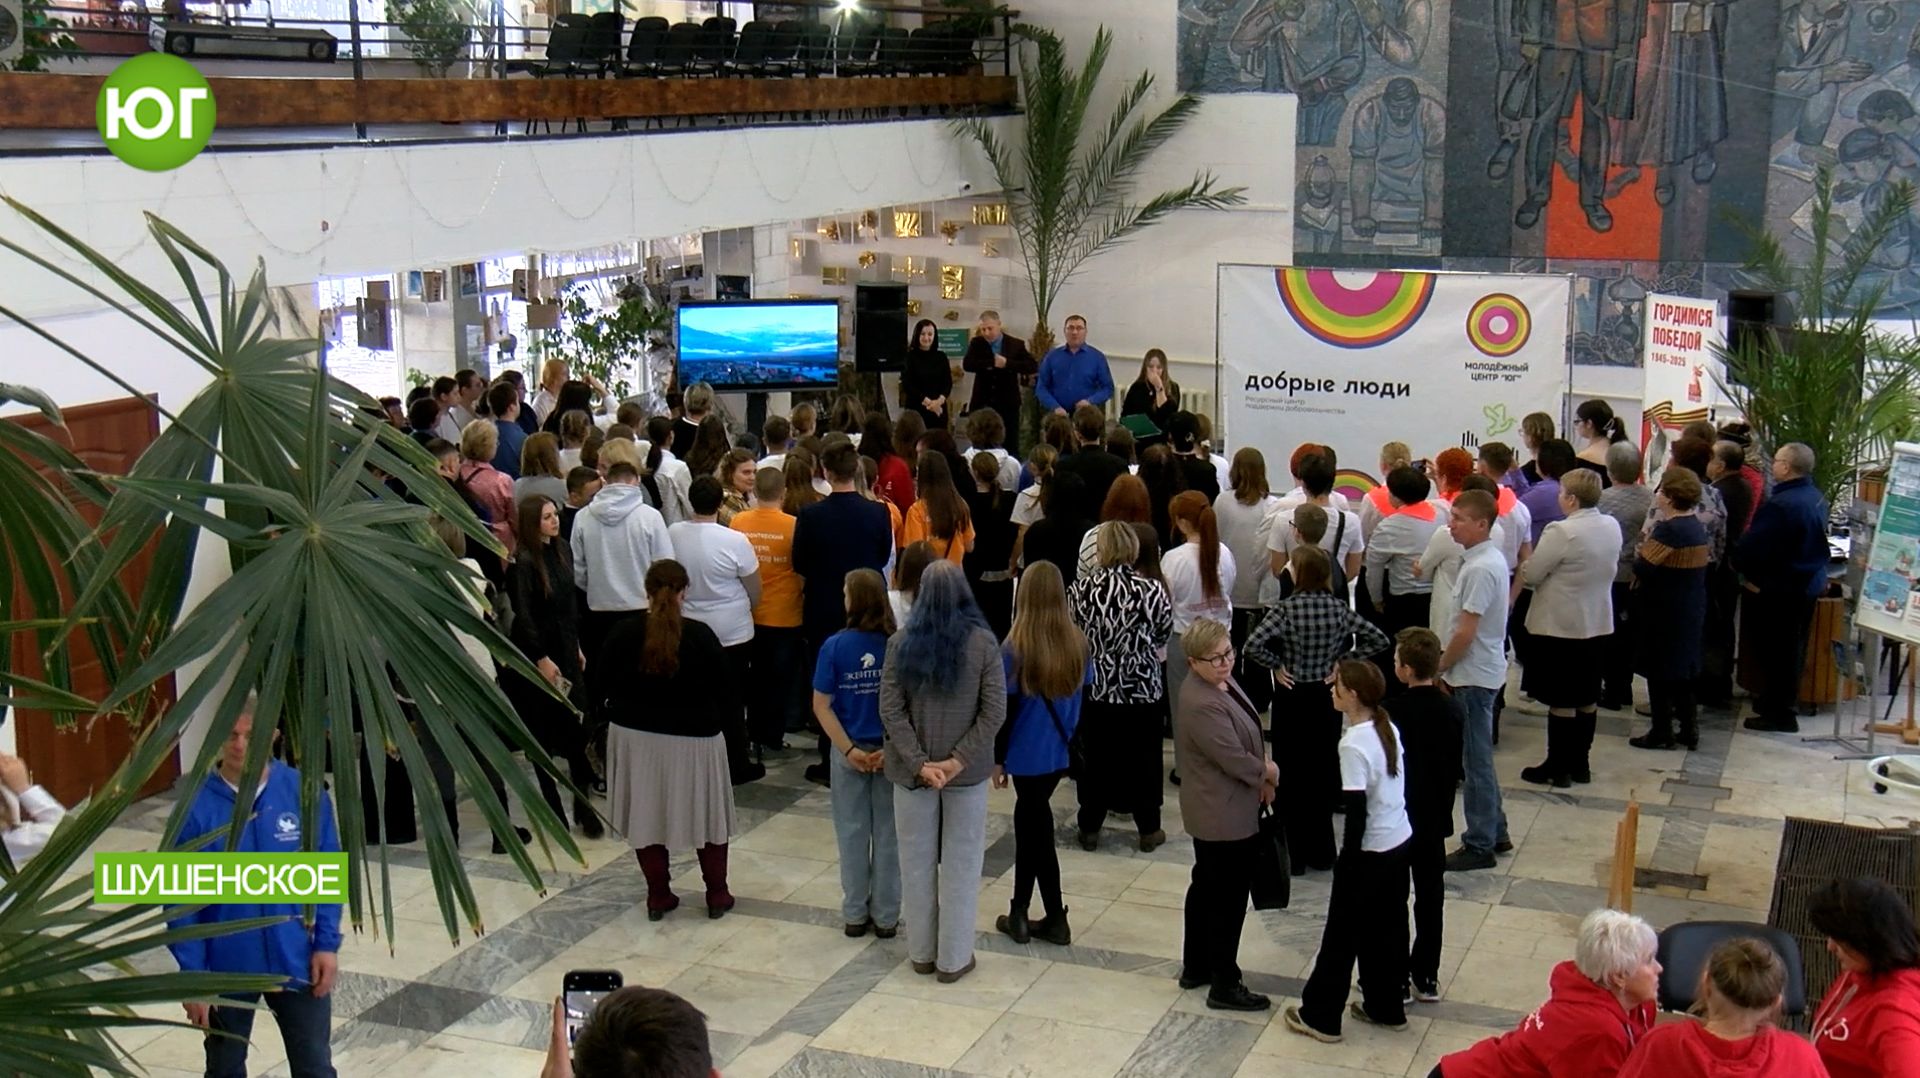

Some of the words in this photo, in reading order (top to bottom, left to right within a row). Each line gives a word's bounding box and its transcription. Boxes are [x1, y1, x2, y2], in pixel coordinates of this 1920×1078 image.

[1653, 303, 1713, 328] ГОРДИМСЯ
[1652, 326, 1703, 352] ПОБЕДОЙ
[1650, 352, 1687, 367] 1945-2025
[1244, 370, 1336, 397] добрые
[1343, 379, 1411, 399] люди
[1471, 372, 1499, 382] ЦЕНТР
